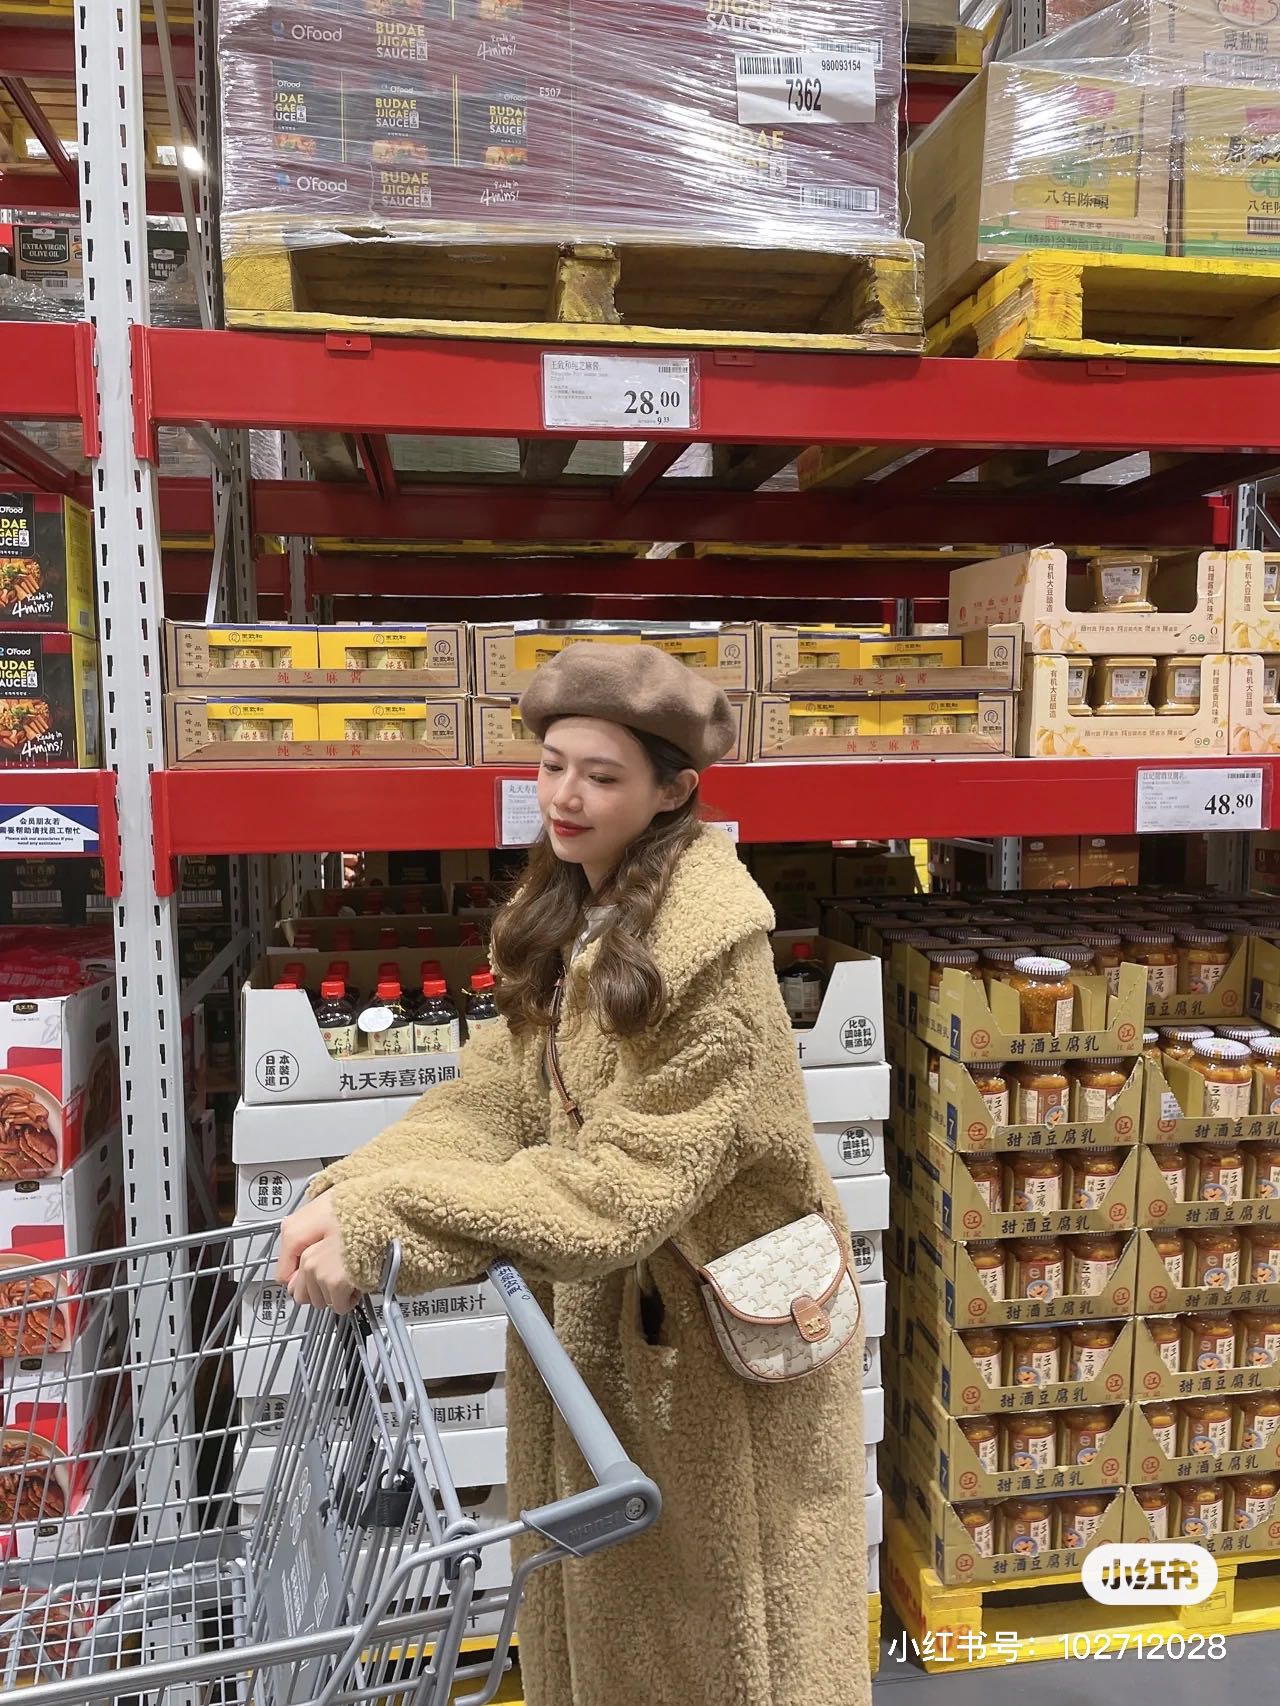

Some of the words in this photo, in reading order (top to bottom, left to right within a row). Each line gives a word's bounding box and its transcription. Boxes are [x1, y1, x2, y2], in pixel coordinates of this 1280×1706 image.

[375, 20, 424, 37] BUDAE
[376, 36, 416, 49] JJIGAE
[376, 47, 416, 59] SAUCE
[821, 60, 861, 72] 980093154
[540, 87, 560, 98] E507
[785, 78, 822, 111] 7362
[375, 98, 417, 110] BUDAE
[376, 109, 409, 119] JJIGAE
[376, 118, 410, 128] SAUCE
[489, 116, 522, 126] JJIGAE
[489, 125, 522, 135] SAUCE
[380, 171, 429, 185] BUDAE
[44, 243, 66, 251] VIRGIN
[624, 390, 680, 415] 28.00
[1205, 794, 1253, 815] 48.80
[20, 817, 61, 826] 会员朋友若
[1010, 1036, 1099, 1054] 甜酒豆腐乳
[1006, 1128, 1096, 1147] 甜酒豆腐乳
[1194, 1121, 1280, 1138] 甜酒豆腐乳
[1186, 1204, 1272, 1222] 甜酒豆腐乳
[1002, 1215, 1090, 1234] 甜酒豆腐乳
[1185, 1289, 1269, 1307] 甜酒豆腐乳
[1006, 1300, 1093, 1319] 甜酒豆腐乳
[1179, 1372, 1262, 1392] 甜酒豆腐乳
[1000, 1387, 1088, 1407] 甜酒豆腐乳
[1177, 1454, 1259, 1476] 甜酒豆腐乳
[997, 1471, 1085, 1492] 甜酒豆腐乳
[1191, 1535, 1252, 1553] 豆腐乳
[993, 1552, 1079, 1574] 甜酒豆腐乳
